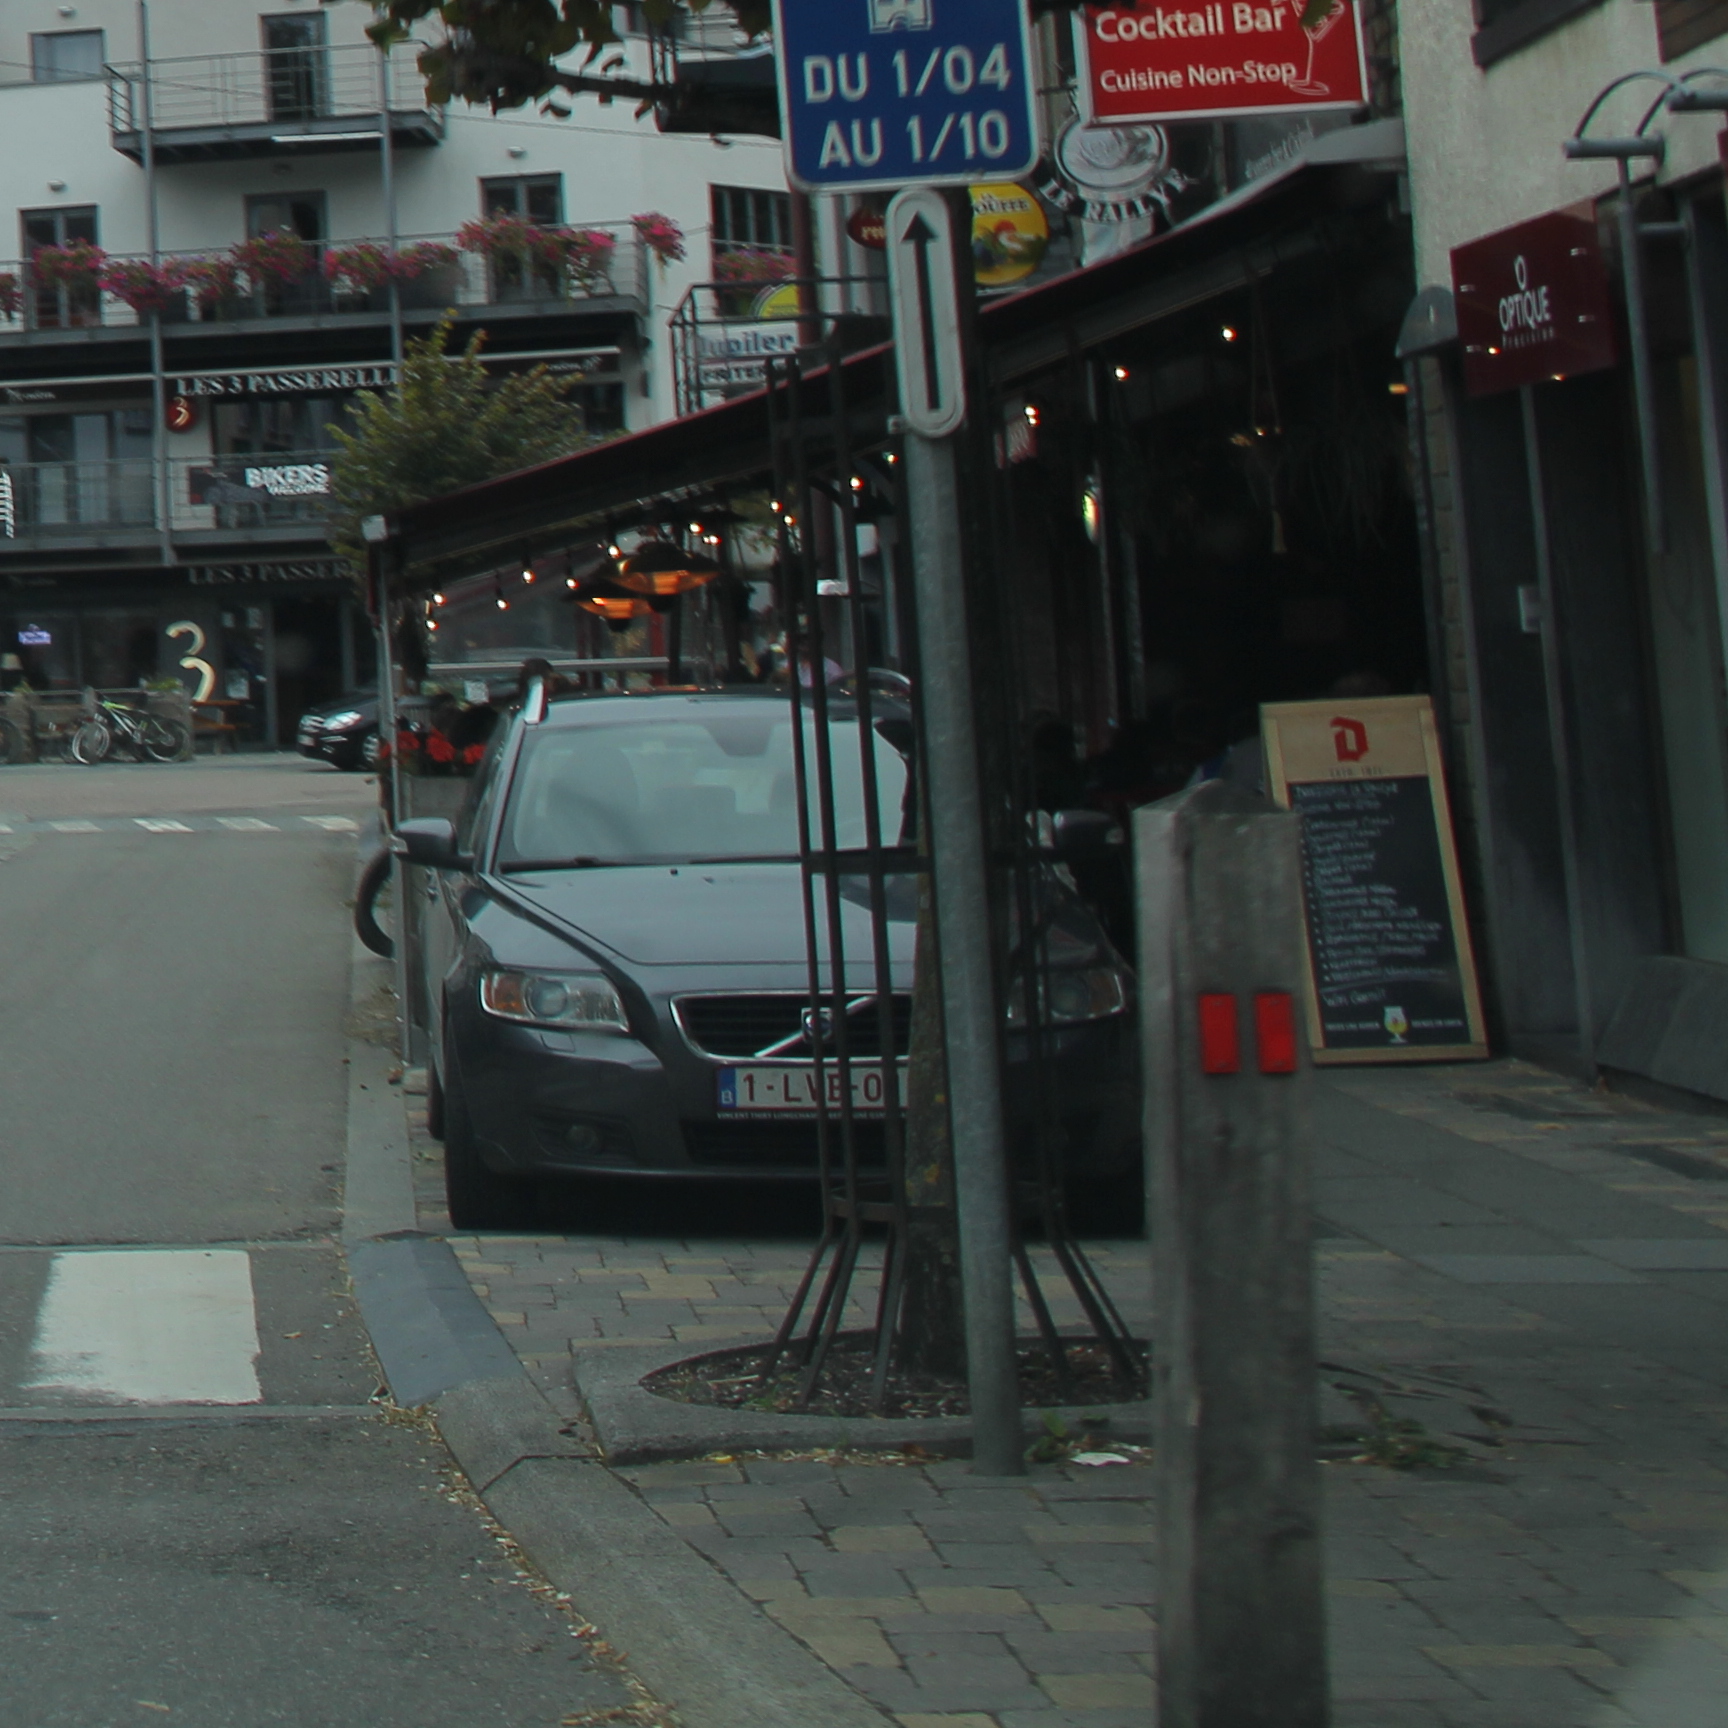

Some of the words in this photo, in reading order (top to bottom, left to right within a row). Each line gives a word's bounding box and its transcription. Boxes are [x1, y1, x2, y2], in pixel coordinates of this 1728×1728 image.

[1095, 2, 1224, 44] Cocktail
[1232, 2, 1287, 34] Bar
[803, 52, 868, 104] DU
[891, 43, 1012, 98] 1/04
[1099, 67, 1184, 94] Cuisine
[1188, 59, 1298, 88] Non-Stop
[818, 118, 882, 170] AU
[905, 110, 1010, 163] 1/10
[1499, 285, 1553, 332] OPTIQUE
[176, 377, 225, 396] LES
[228, 375, 243, 394] 3
[247, 365, 398, 393] PASSERELL
[245, 463, 330, 489] BIKERS
[257, 560, 351, 583] PASSER
